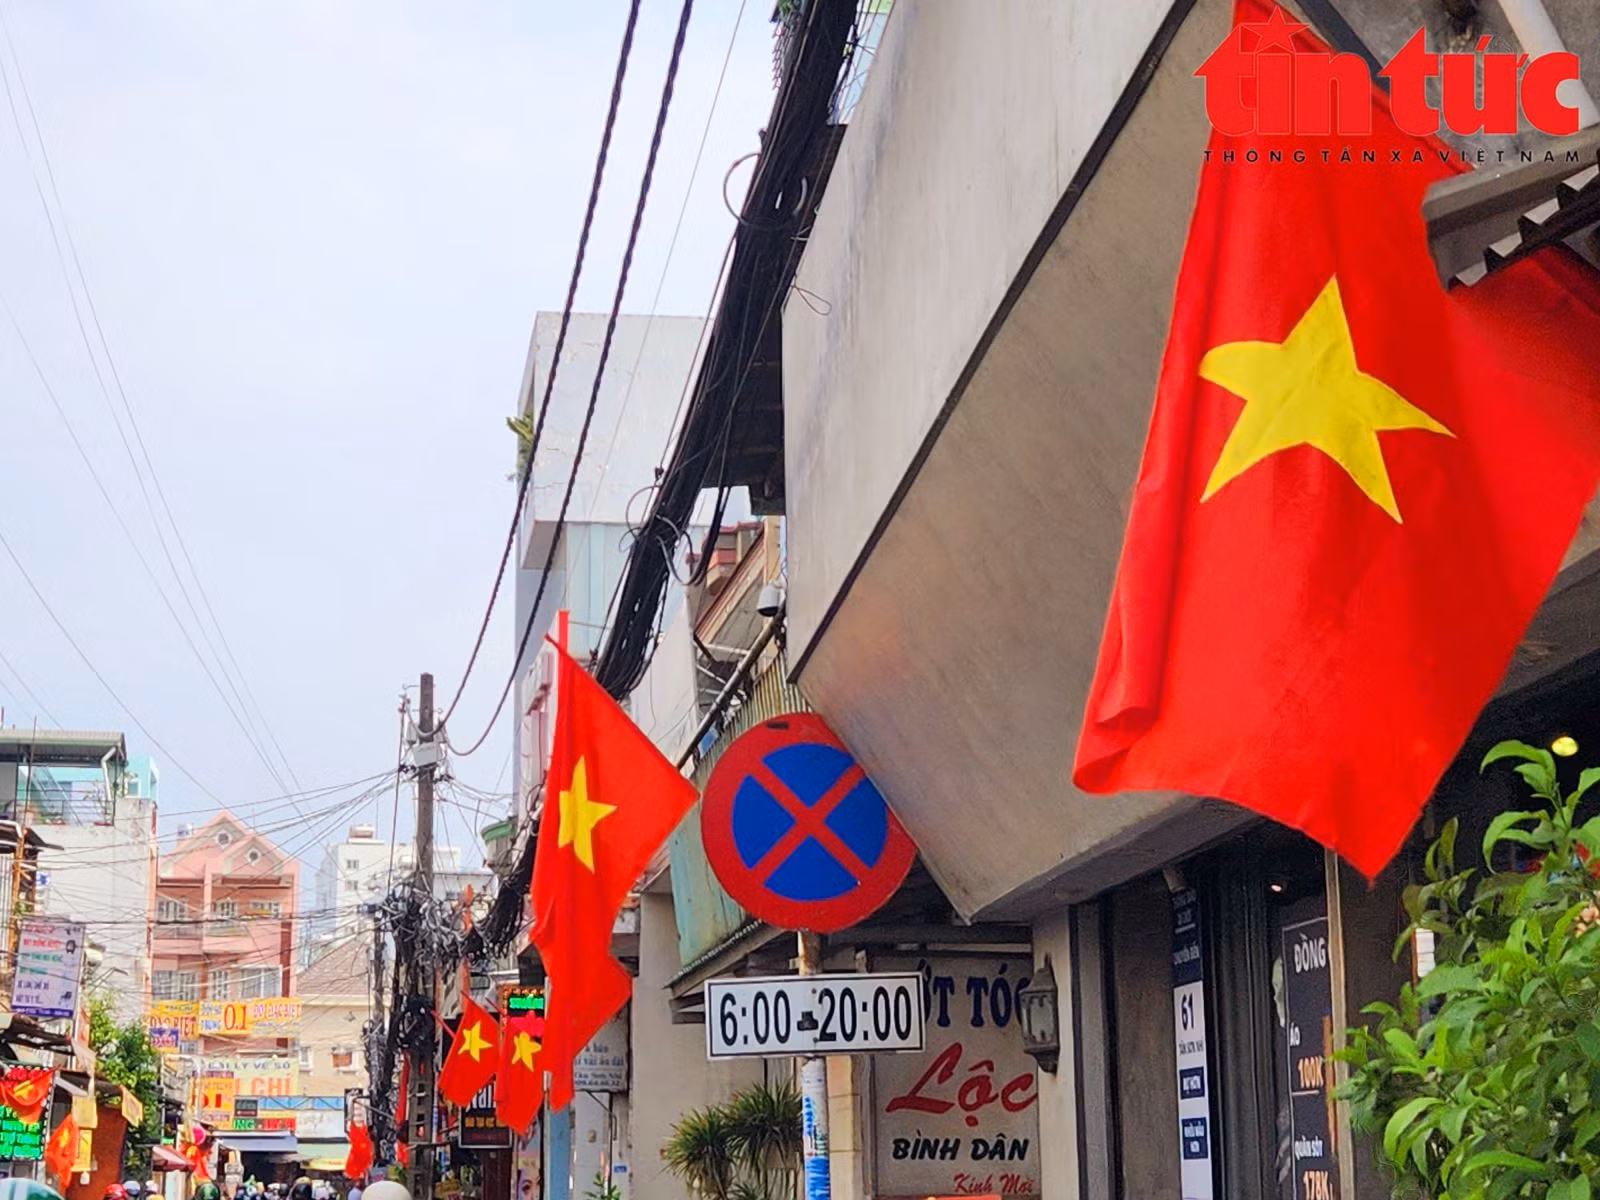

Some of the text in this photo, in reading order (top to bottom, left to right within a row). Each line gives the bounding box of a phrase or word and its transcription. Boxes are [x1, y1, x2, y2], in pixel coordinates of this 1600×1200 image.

[1294, 932, 1327, 974] ĐỒNG
[719, 990, 791, 1047] 6:00
[818, 985, 912, 1043] 20:00
[1181, 992, 1195, 1031] 61
[885, 1042, 1039, 1127] Lộc
[1298, 1055, 1324, 1089] 100K
[892, 1129, 1029, 1160] BÌNH DÂN
[1303, 1170, 1330, 1200] 178K
